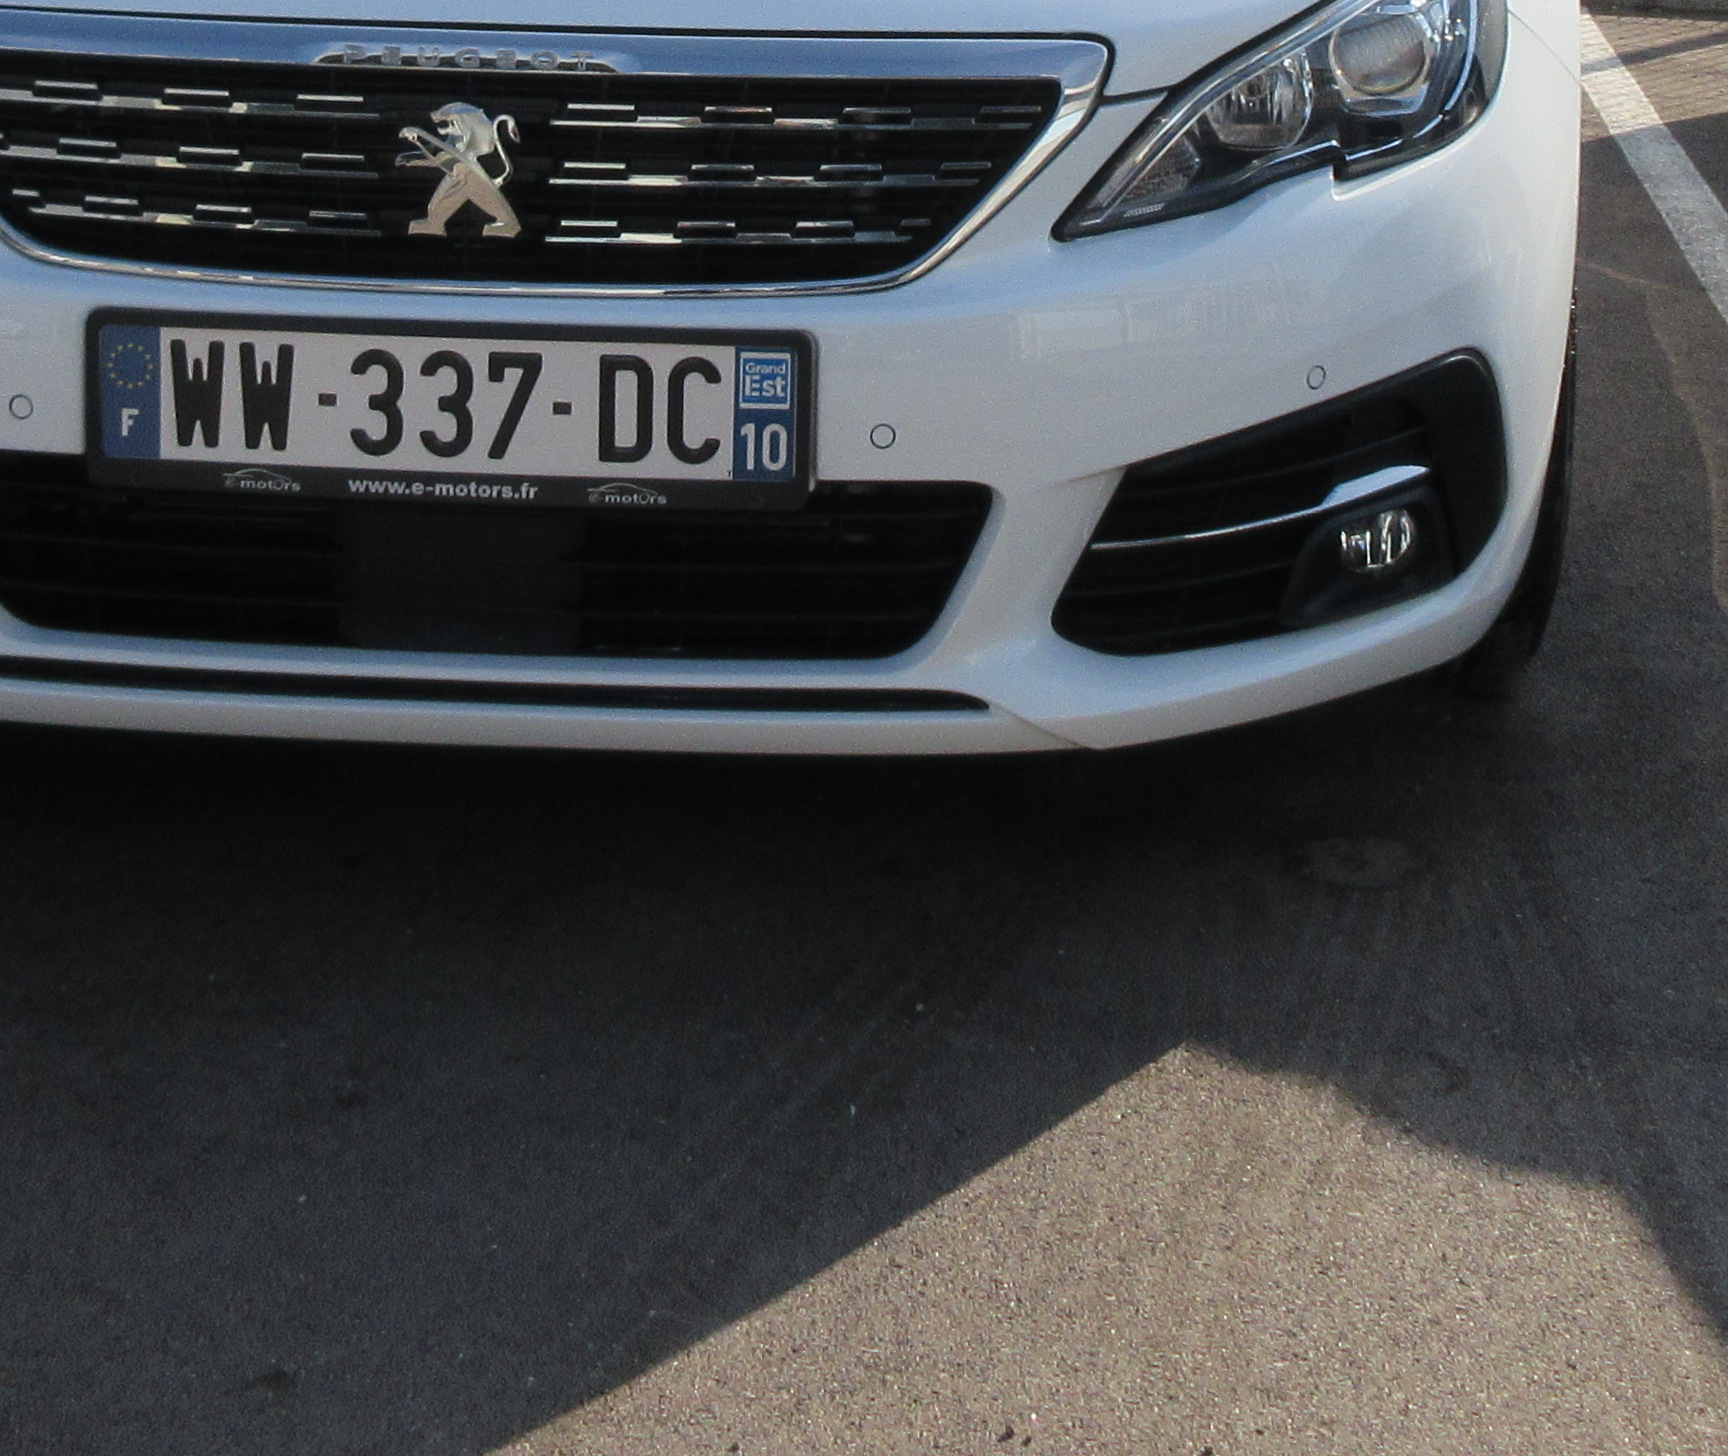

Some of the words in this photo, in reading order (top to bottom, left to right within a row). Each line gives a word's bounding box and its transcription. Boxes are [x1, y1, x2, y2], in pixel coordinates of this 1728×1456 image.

[343, 43, 595, 72] PEUGEOT
[745, 362, 786, 375] Grand
[744, 375, 786, 397] Est
[121, 407, 140, 436] F
[740, 422, 788, 472] 10
[347, 476, 539, 501] www.e-motors.fr
